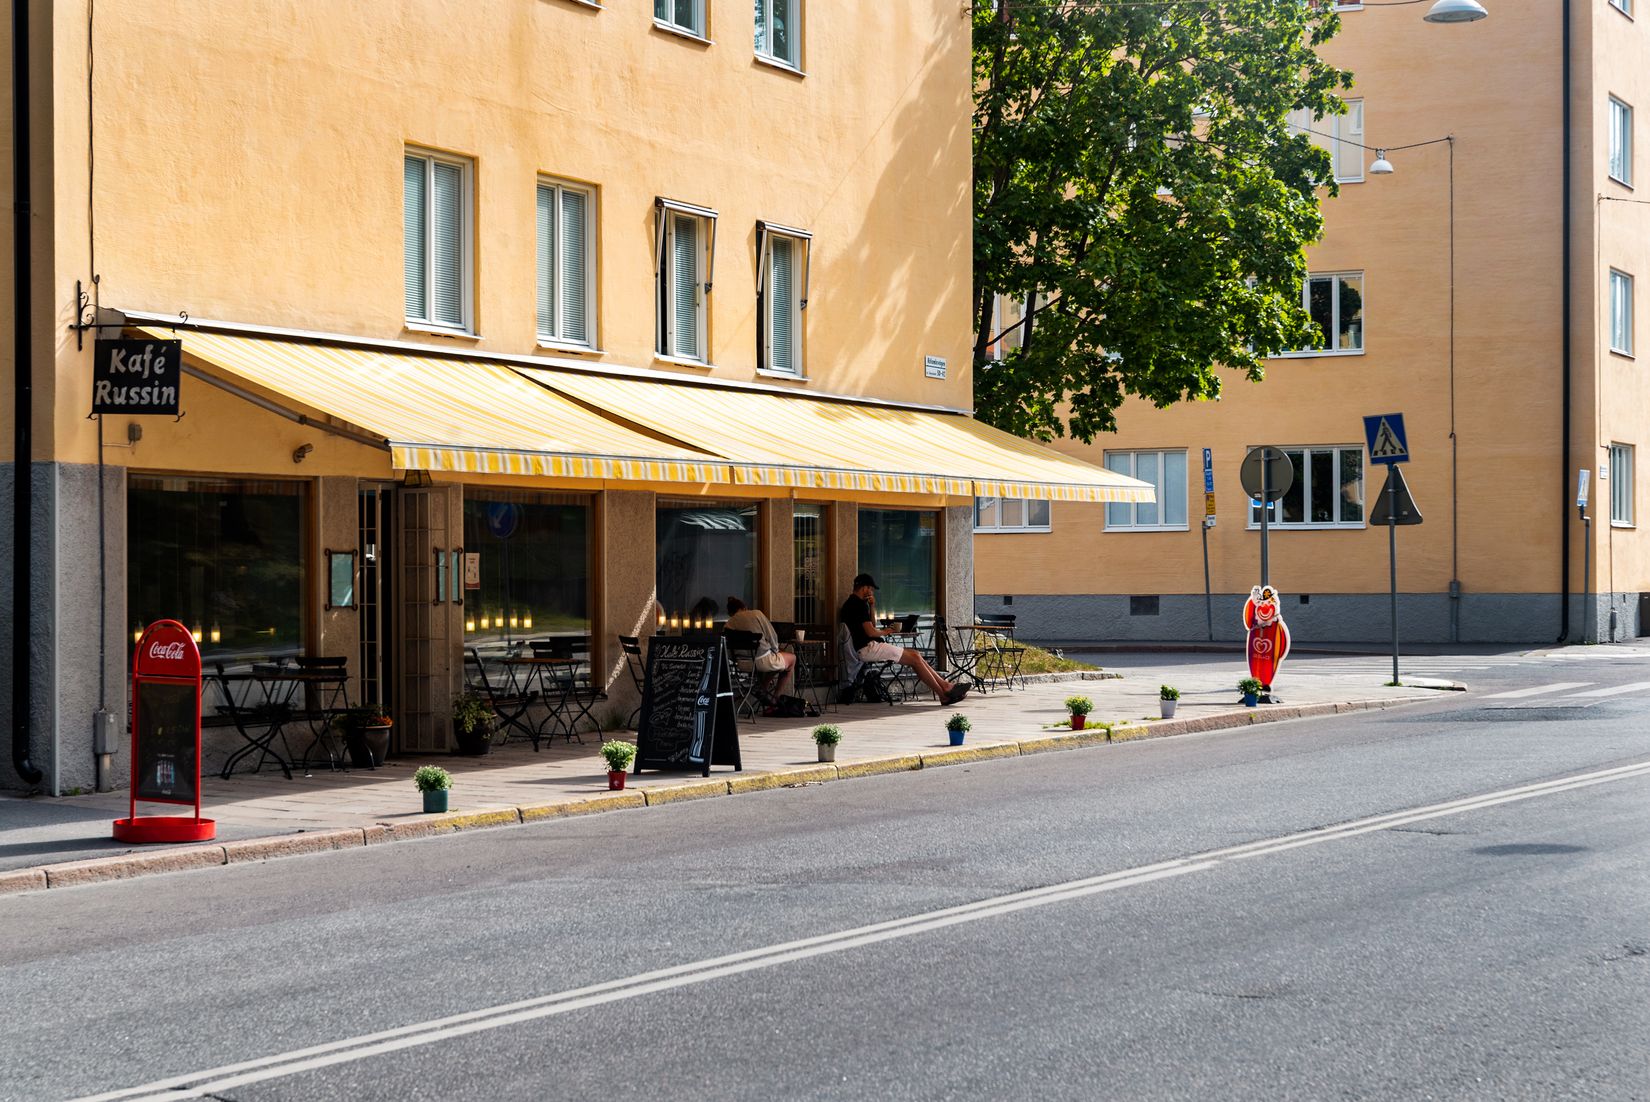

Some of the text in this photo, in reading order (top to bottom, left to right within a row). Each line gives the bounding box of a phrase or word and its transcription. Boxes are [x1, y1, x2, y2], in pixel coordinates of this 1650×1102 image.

[109, 344, 167, 379] Kafé
[95, 380, 176, 405] Russin
[1205, 450, 1211, 468] P
